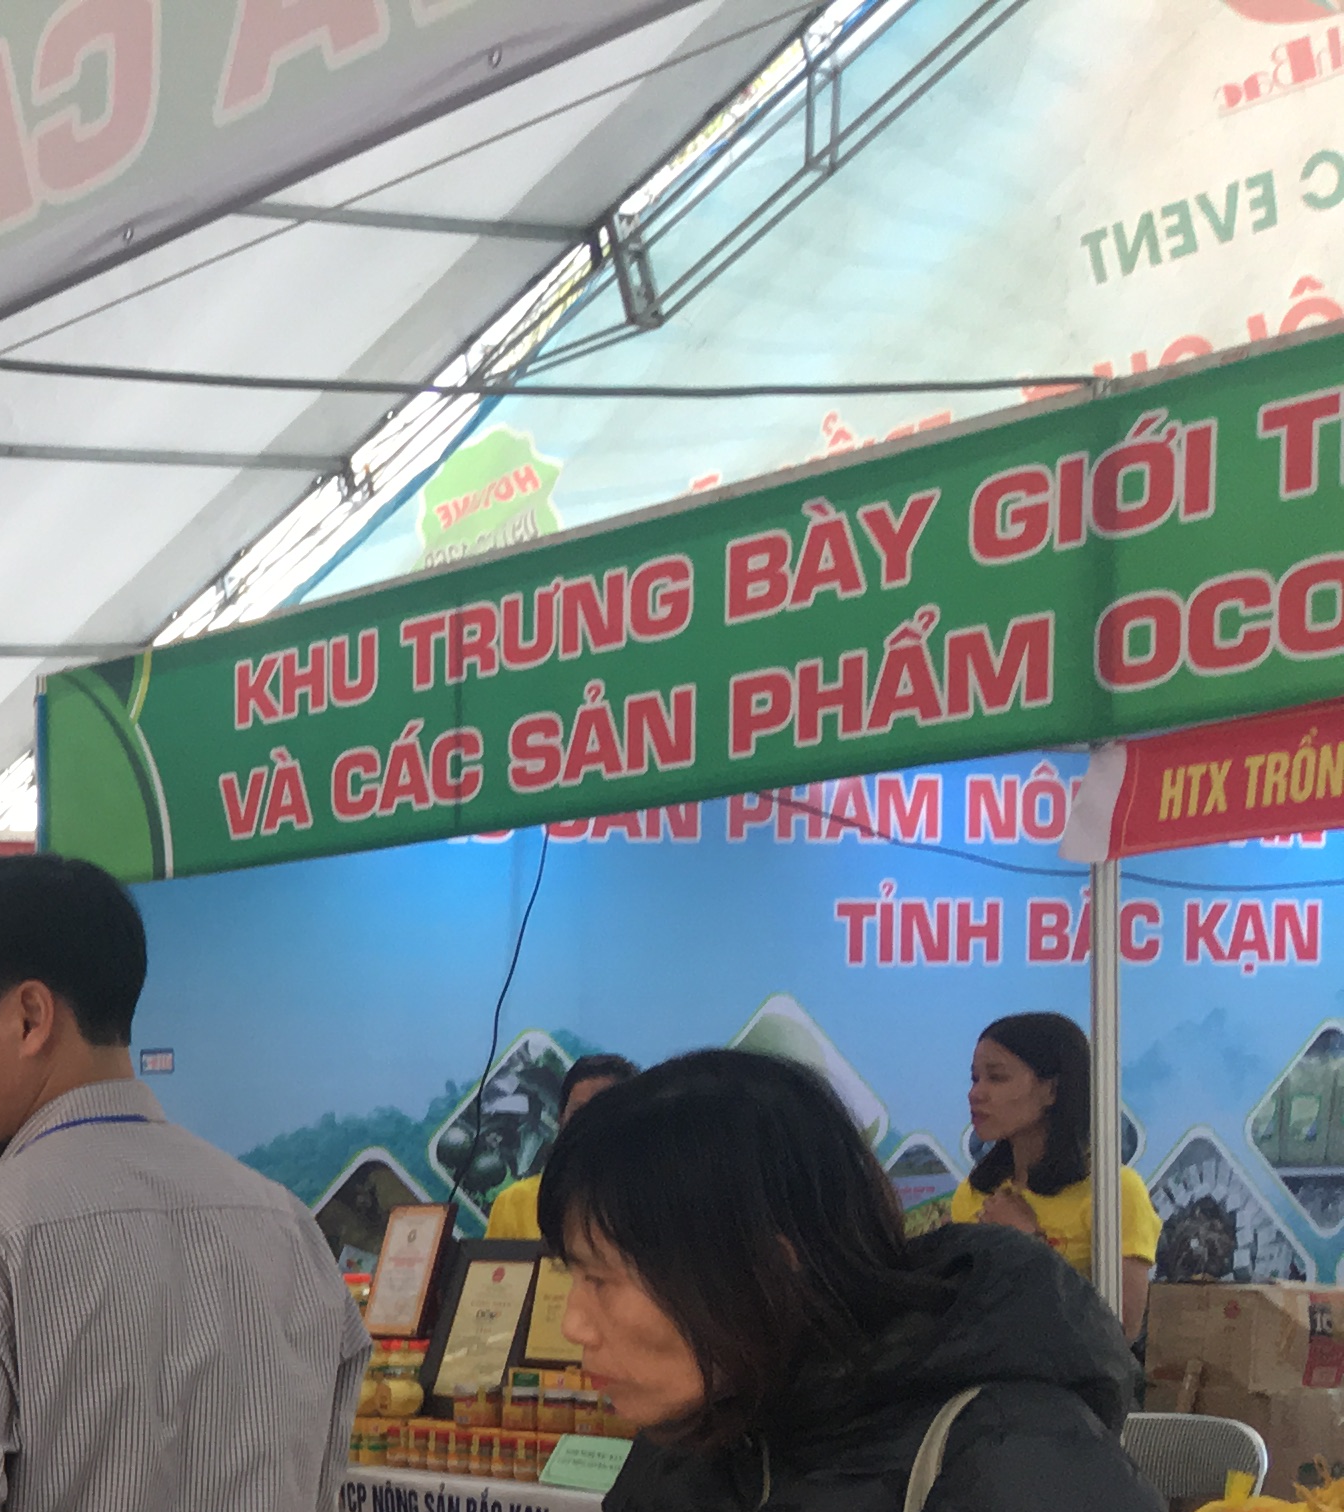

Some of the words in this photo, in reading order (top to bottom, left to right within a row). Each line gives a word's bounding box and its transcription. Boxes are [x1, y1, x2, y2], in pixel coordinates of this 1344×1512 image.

[234, 626, 379, 730] KHU
[400, 552, 695, 693] TRƯNG
[724, 495, 942, 626] BÀY
[969, 407, 1219, 566] GIỚI
[219, 745, 313, 840] VÀ
[330, 717, 484, 823] CÁC
[508, 677, 697, 794] SẢN
[728, 602, 1056, 761] PHẨM
[1158, 758, 1233, 822] HTX
[834, 876, 1005, 967] TỈNH
[1183, 897, 1323, 976] KẠN
